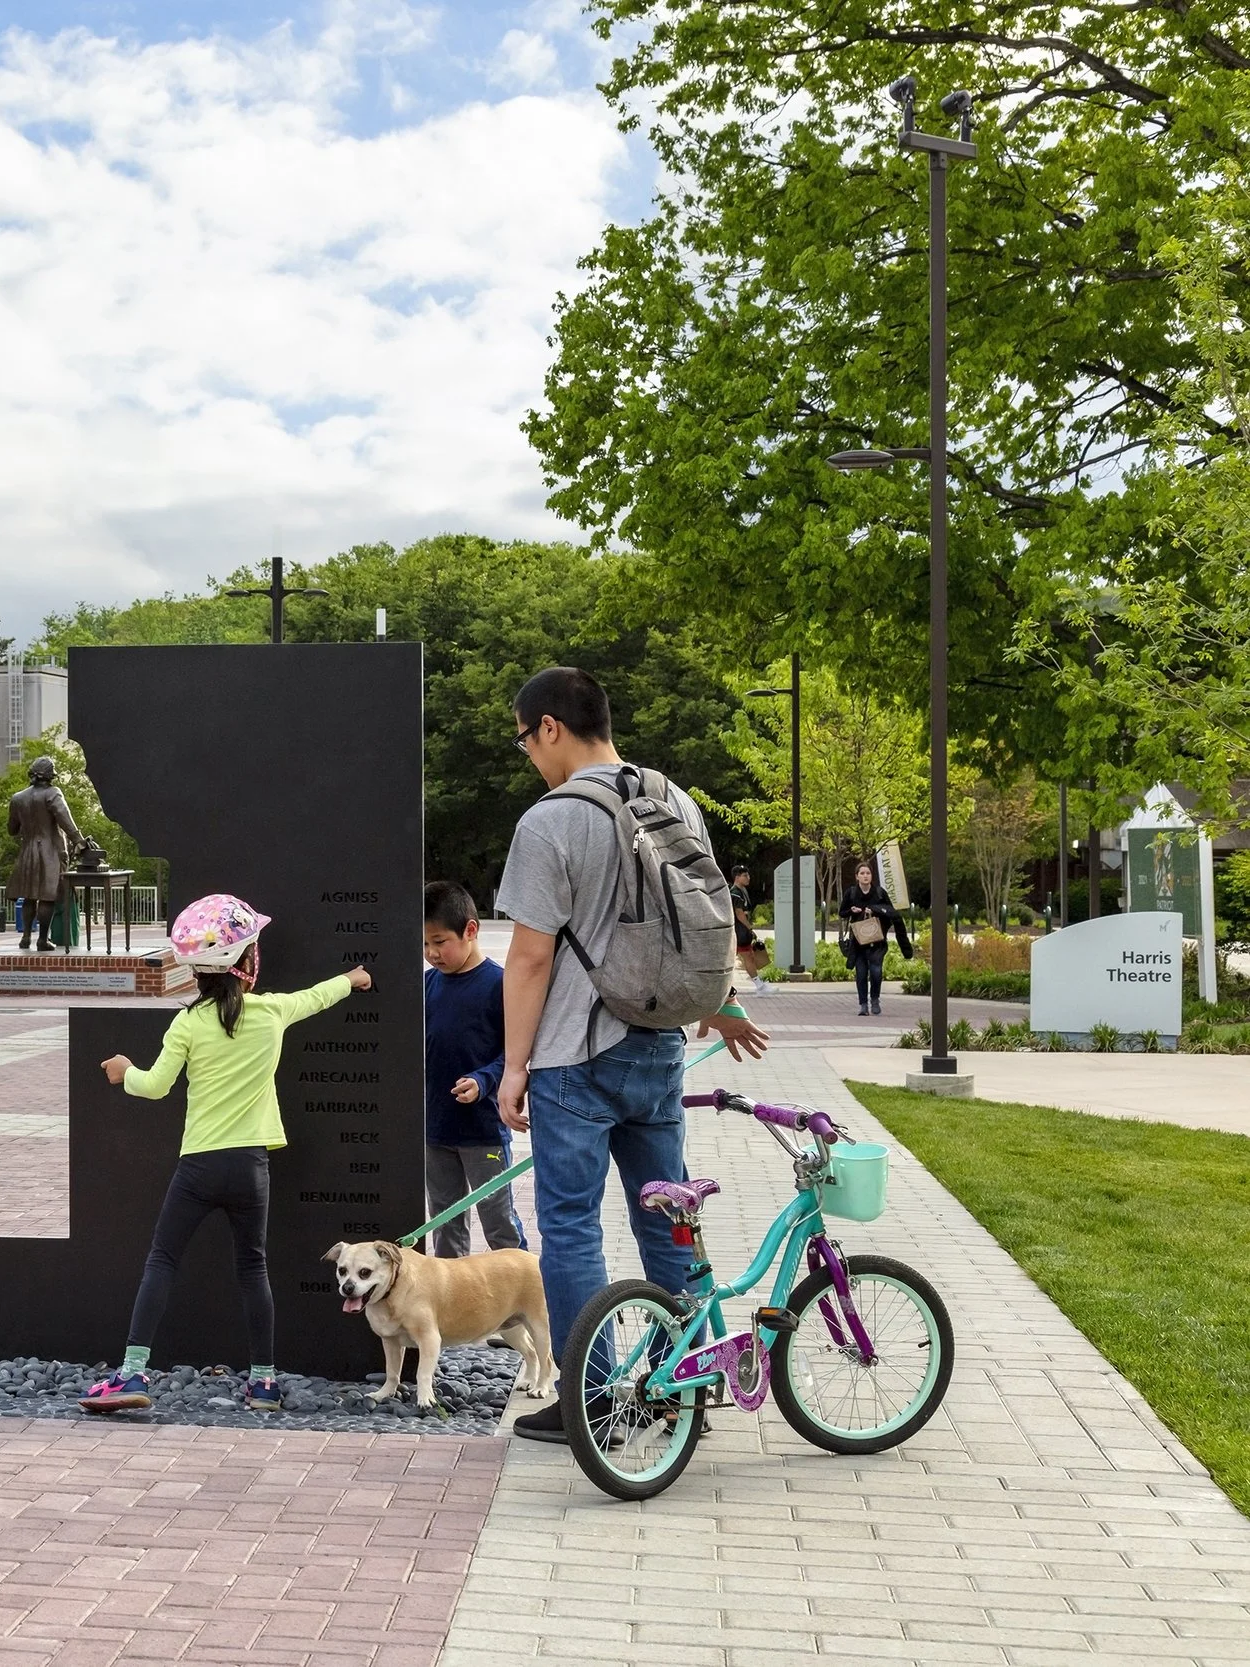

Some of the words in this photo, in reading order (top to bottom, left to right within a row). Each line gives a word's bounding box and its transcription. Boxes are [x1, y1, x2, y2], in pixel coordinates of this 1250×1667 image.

[321, 892, 378, 903] AGNISS
[334, 922, 379, 933] ALICE
[342, 952, 378, 963] AMY
[1123, 951, 1171, 964] Harris
[1106, 968, 1171, 982] Theatre
[344, 1012, 379, 1023] ANN
[303, 1042, 379, 1053] ANTHONY
[298, 1071, 380, 1083] ARECAJAH
[305, 1102, 380, 1113] BARBARA
[340, 1132, 380, 1143] BECK
[350, 1162, 380, 1174] BEN
[300, 1192, 380, 1203] BENJAMIN
[343, 1222, 381, 1234] BESS
